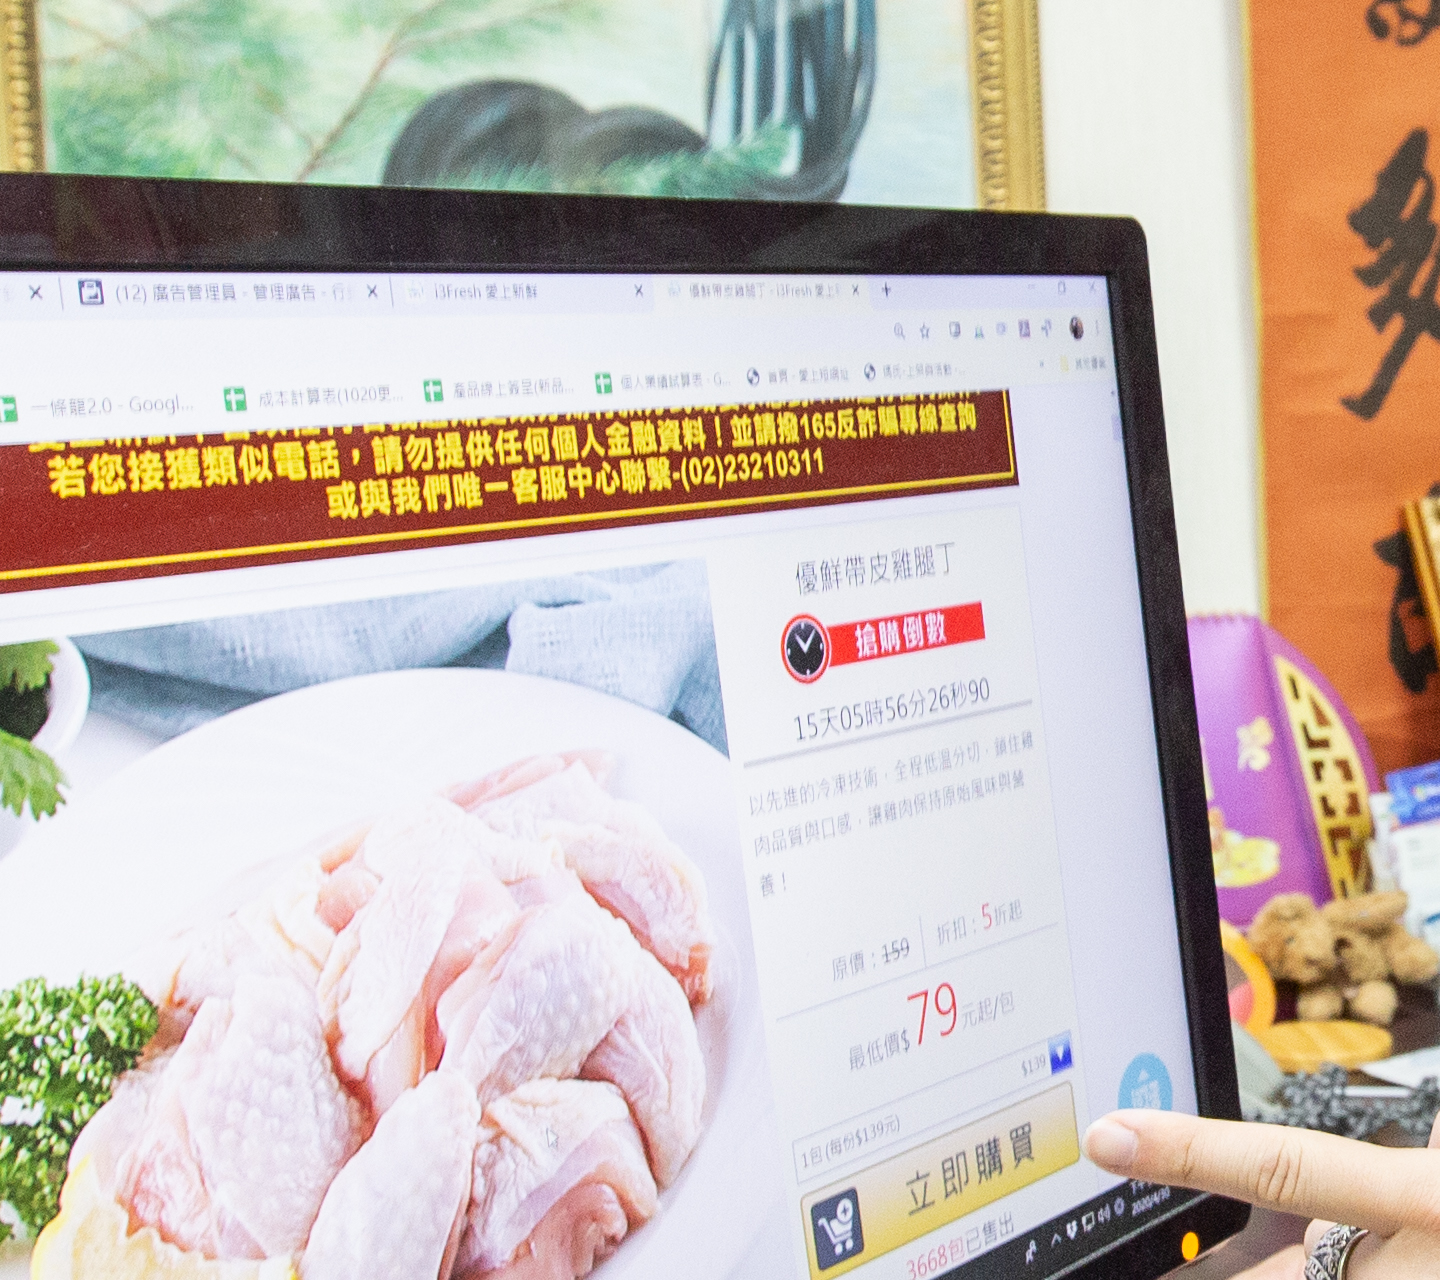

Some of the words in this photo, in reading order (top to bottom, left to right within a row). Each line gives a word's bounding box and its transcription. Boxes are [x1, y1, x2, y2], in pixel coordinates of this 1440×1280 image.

[795, 542, 955, 596] 優鮮帶皮雞腿丁
[854, 610, 947, 658] 搶購倒數
[794, 677, 990, 742] 15天05時56分26秒90
[1021, 1055, 1046, 1077] $139
[906, 1122, 1035, 1216] 立即購買
